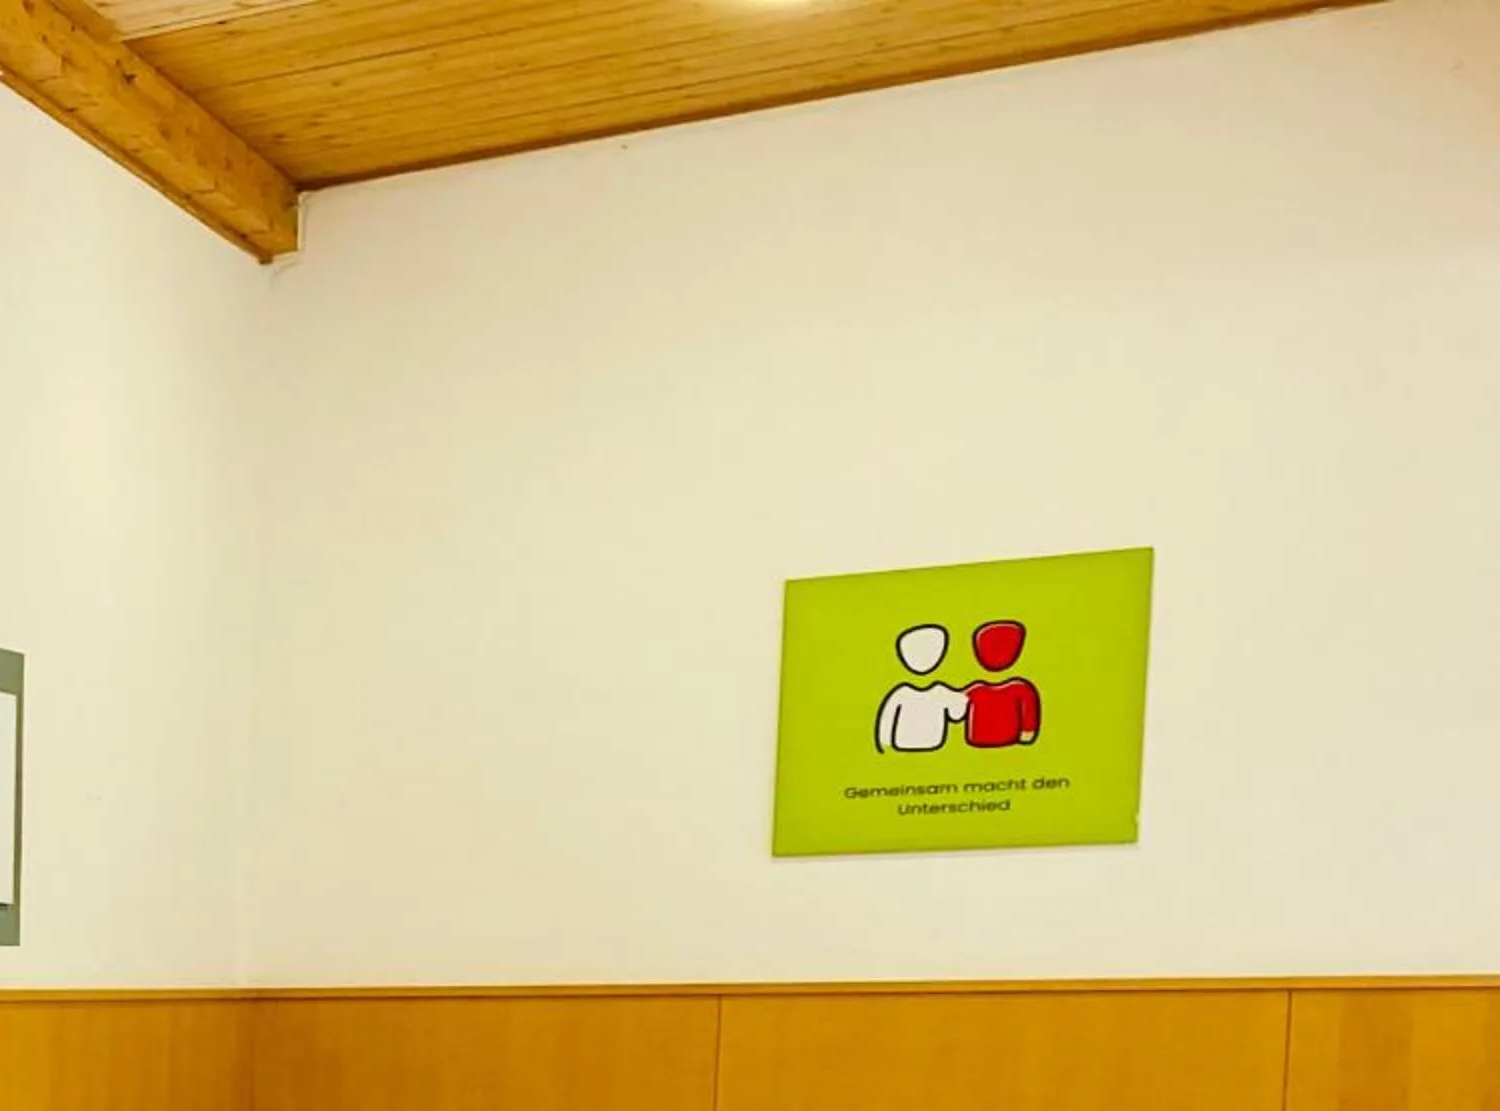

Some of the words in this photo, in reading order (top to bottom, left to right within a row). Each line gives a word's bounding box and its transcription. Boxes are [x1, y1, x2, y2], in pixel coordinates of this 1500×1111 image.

[843, 783, 959, 799] Gemeinsam
[963, 778, 1027, 794] macht
[1032, 775, 1070, 790] den
